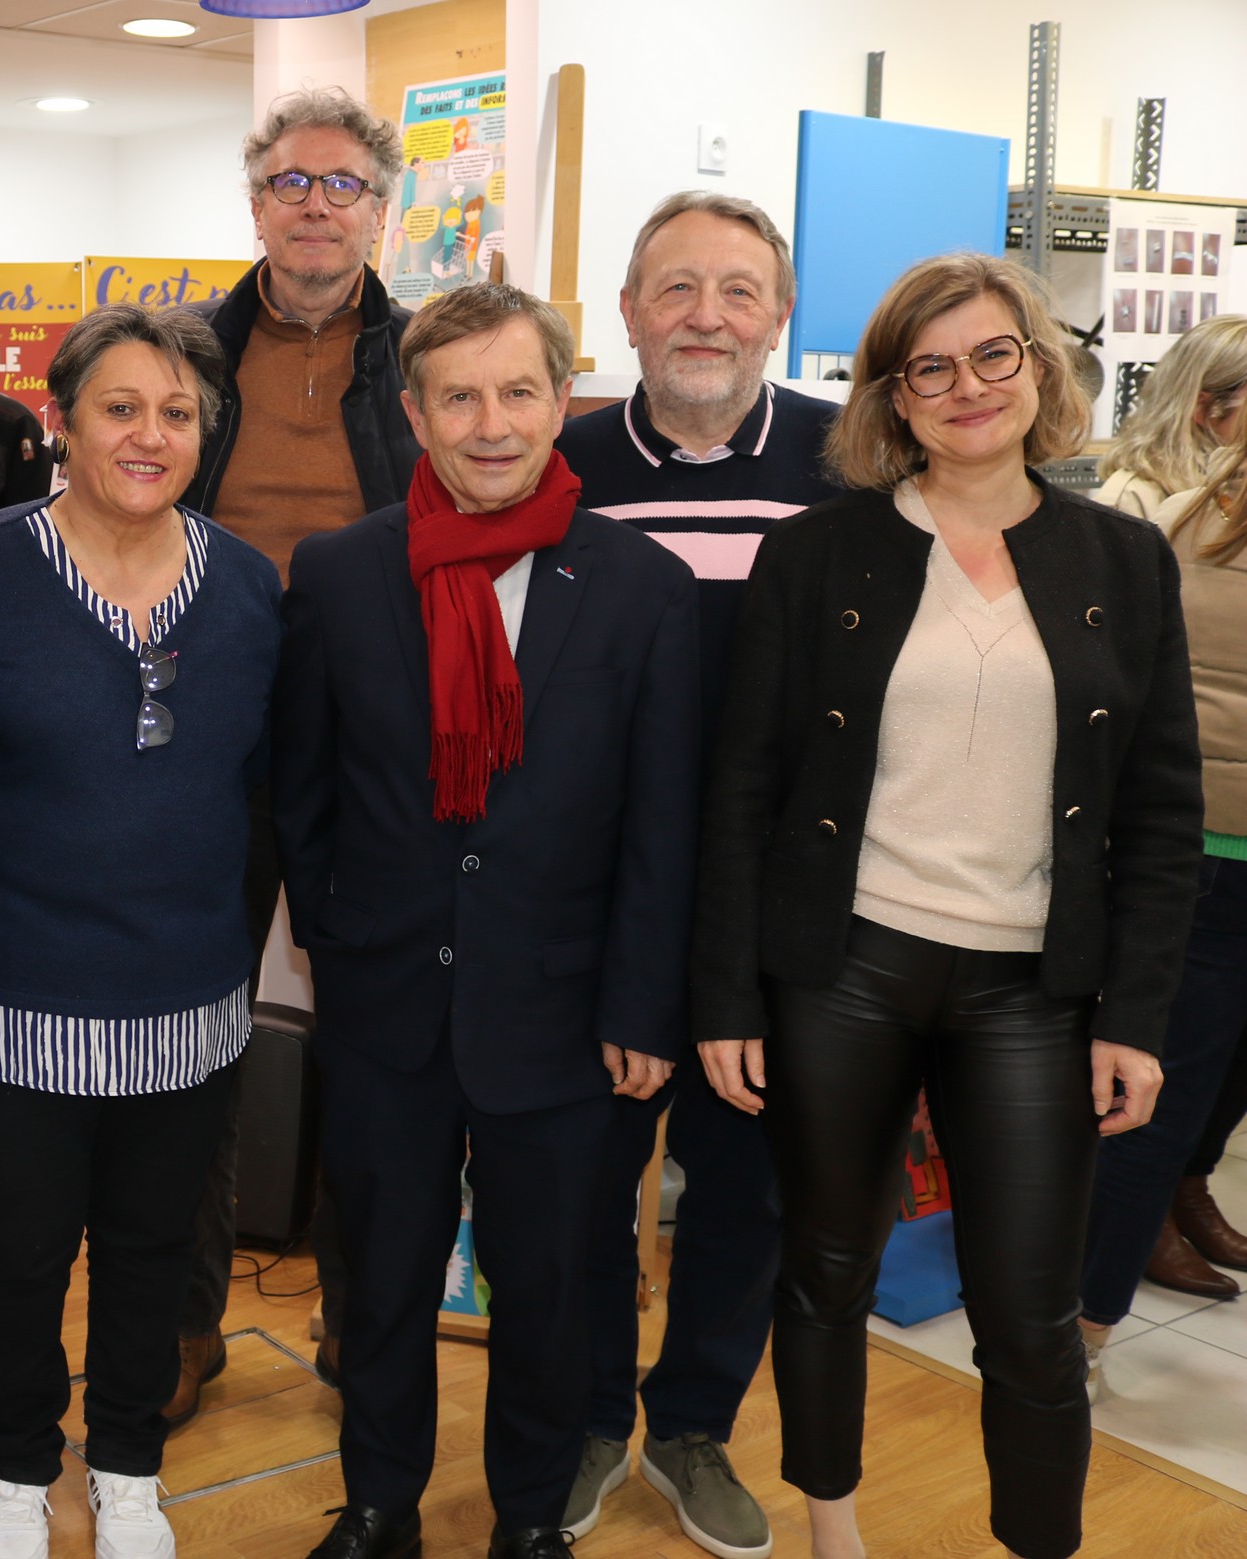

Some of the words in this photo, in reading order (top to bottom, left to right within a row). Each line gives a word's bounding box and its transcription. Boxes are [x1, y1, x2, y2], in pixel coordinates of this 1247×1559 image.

[464, 86, 476, 96] LES
[420, 106, 432, 116] DES
[96, 266, 202, 306] C'est
[9, 325, 48, 342] suis
[4, 373, 49, 391] l'esse
